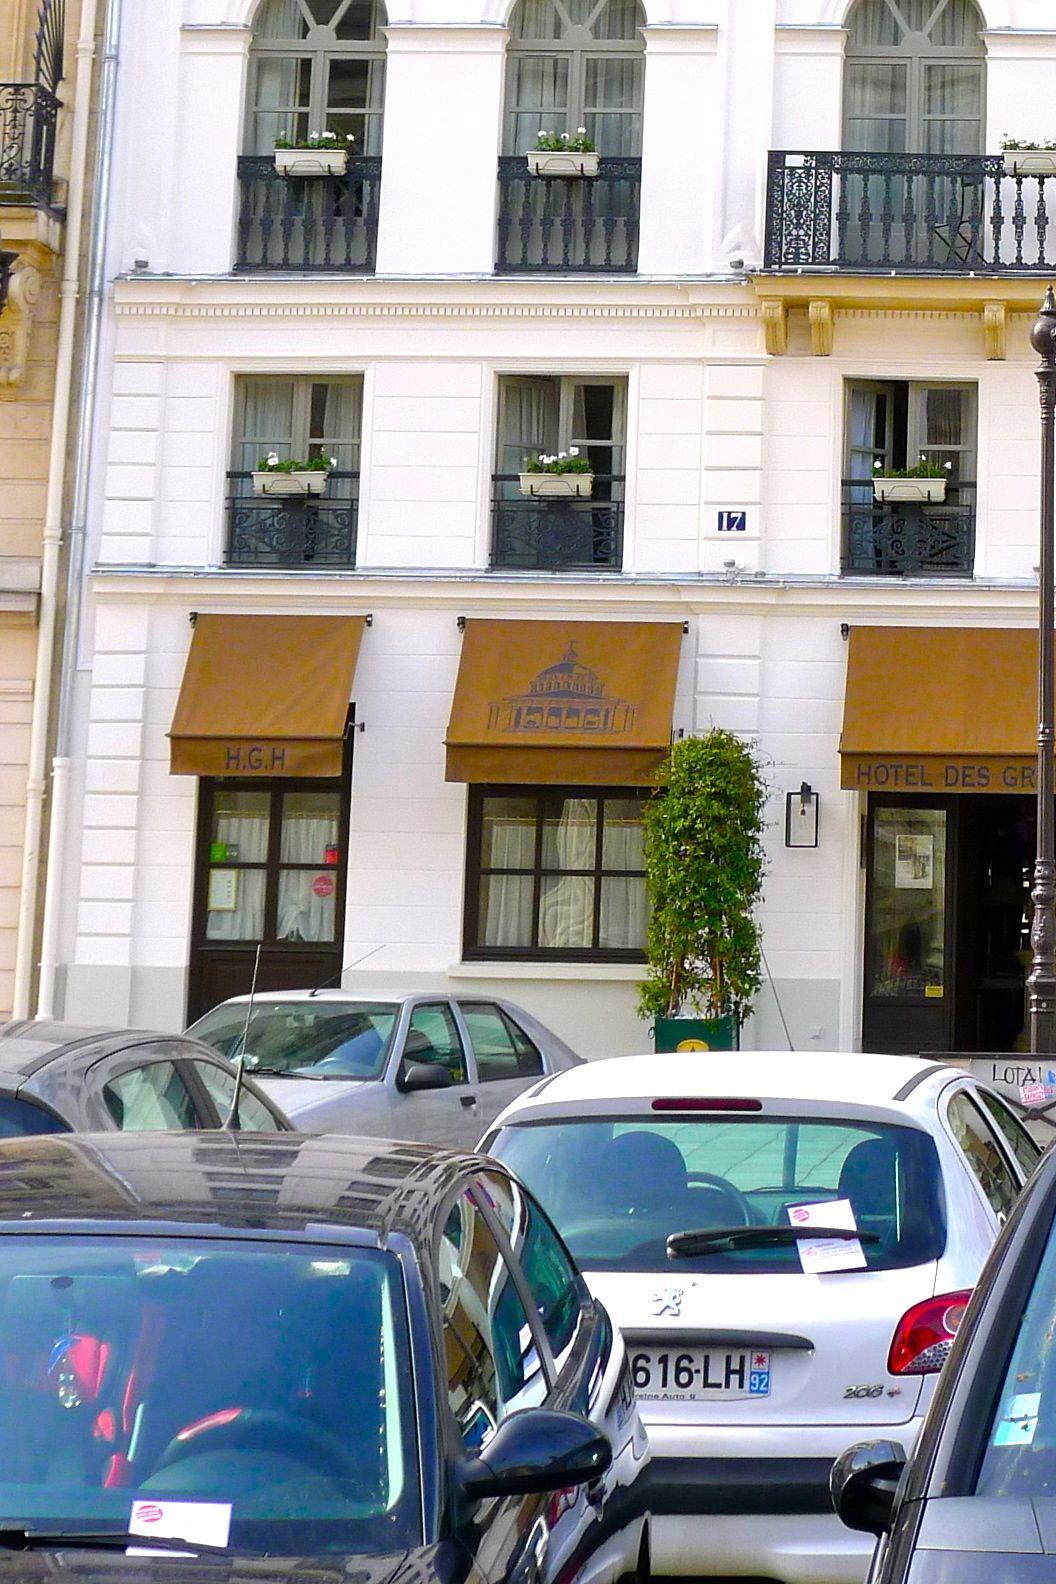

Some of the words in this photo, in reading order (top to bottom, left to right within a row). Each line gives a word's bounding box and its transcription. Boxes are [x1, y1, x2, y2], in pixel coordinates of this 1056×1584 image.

[722, 512, 742, 531] 17
[225, 747, 285, 770] H.G.H
[856, 764, 932, 786] HOTEL
[944, 766, 990, 787] DES
[750, 1374, 769, 1391] 92
